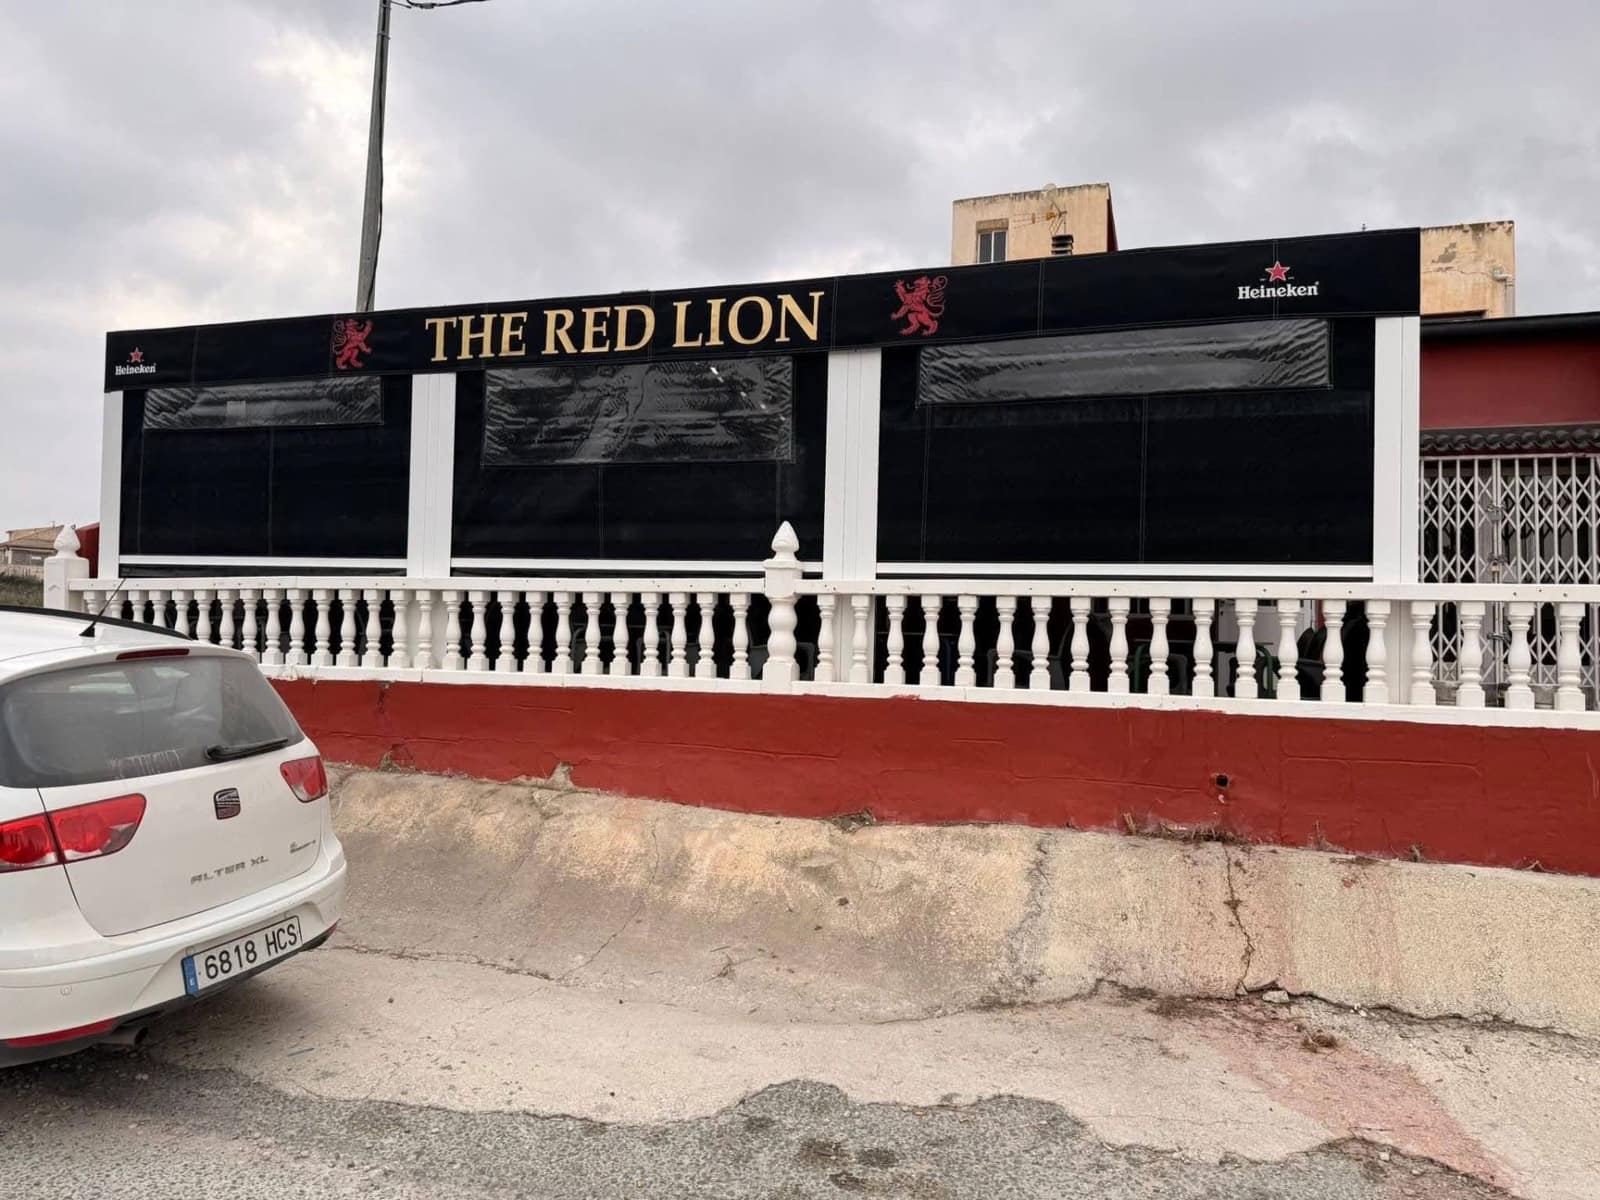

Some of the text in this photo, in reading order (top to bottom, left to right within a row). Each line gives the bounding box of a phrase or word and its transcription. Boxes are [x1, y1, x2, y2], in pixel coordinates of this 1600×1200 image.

[1238, 283, 1319, 299] Heineken
[425, 291, 825, 362] THE RED LION
[115, 364, 156, 376] Heineken
[250, 855, 269, 866] XL
[204, 924, 298, 979] 6818 HCS
